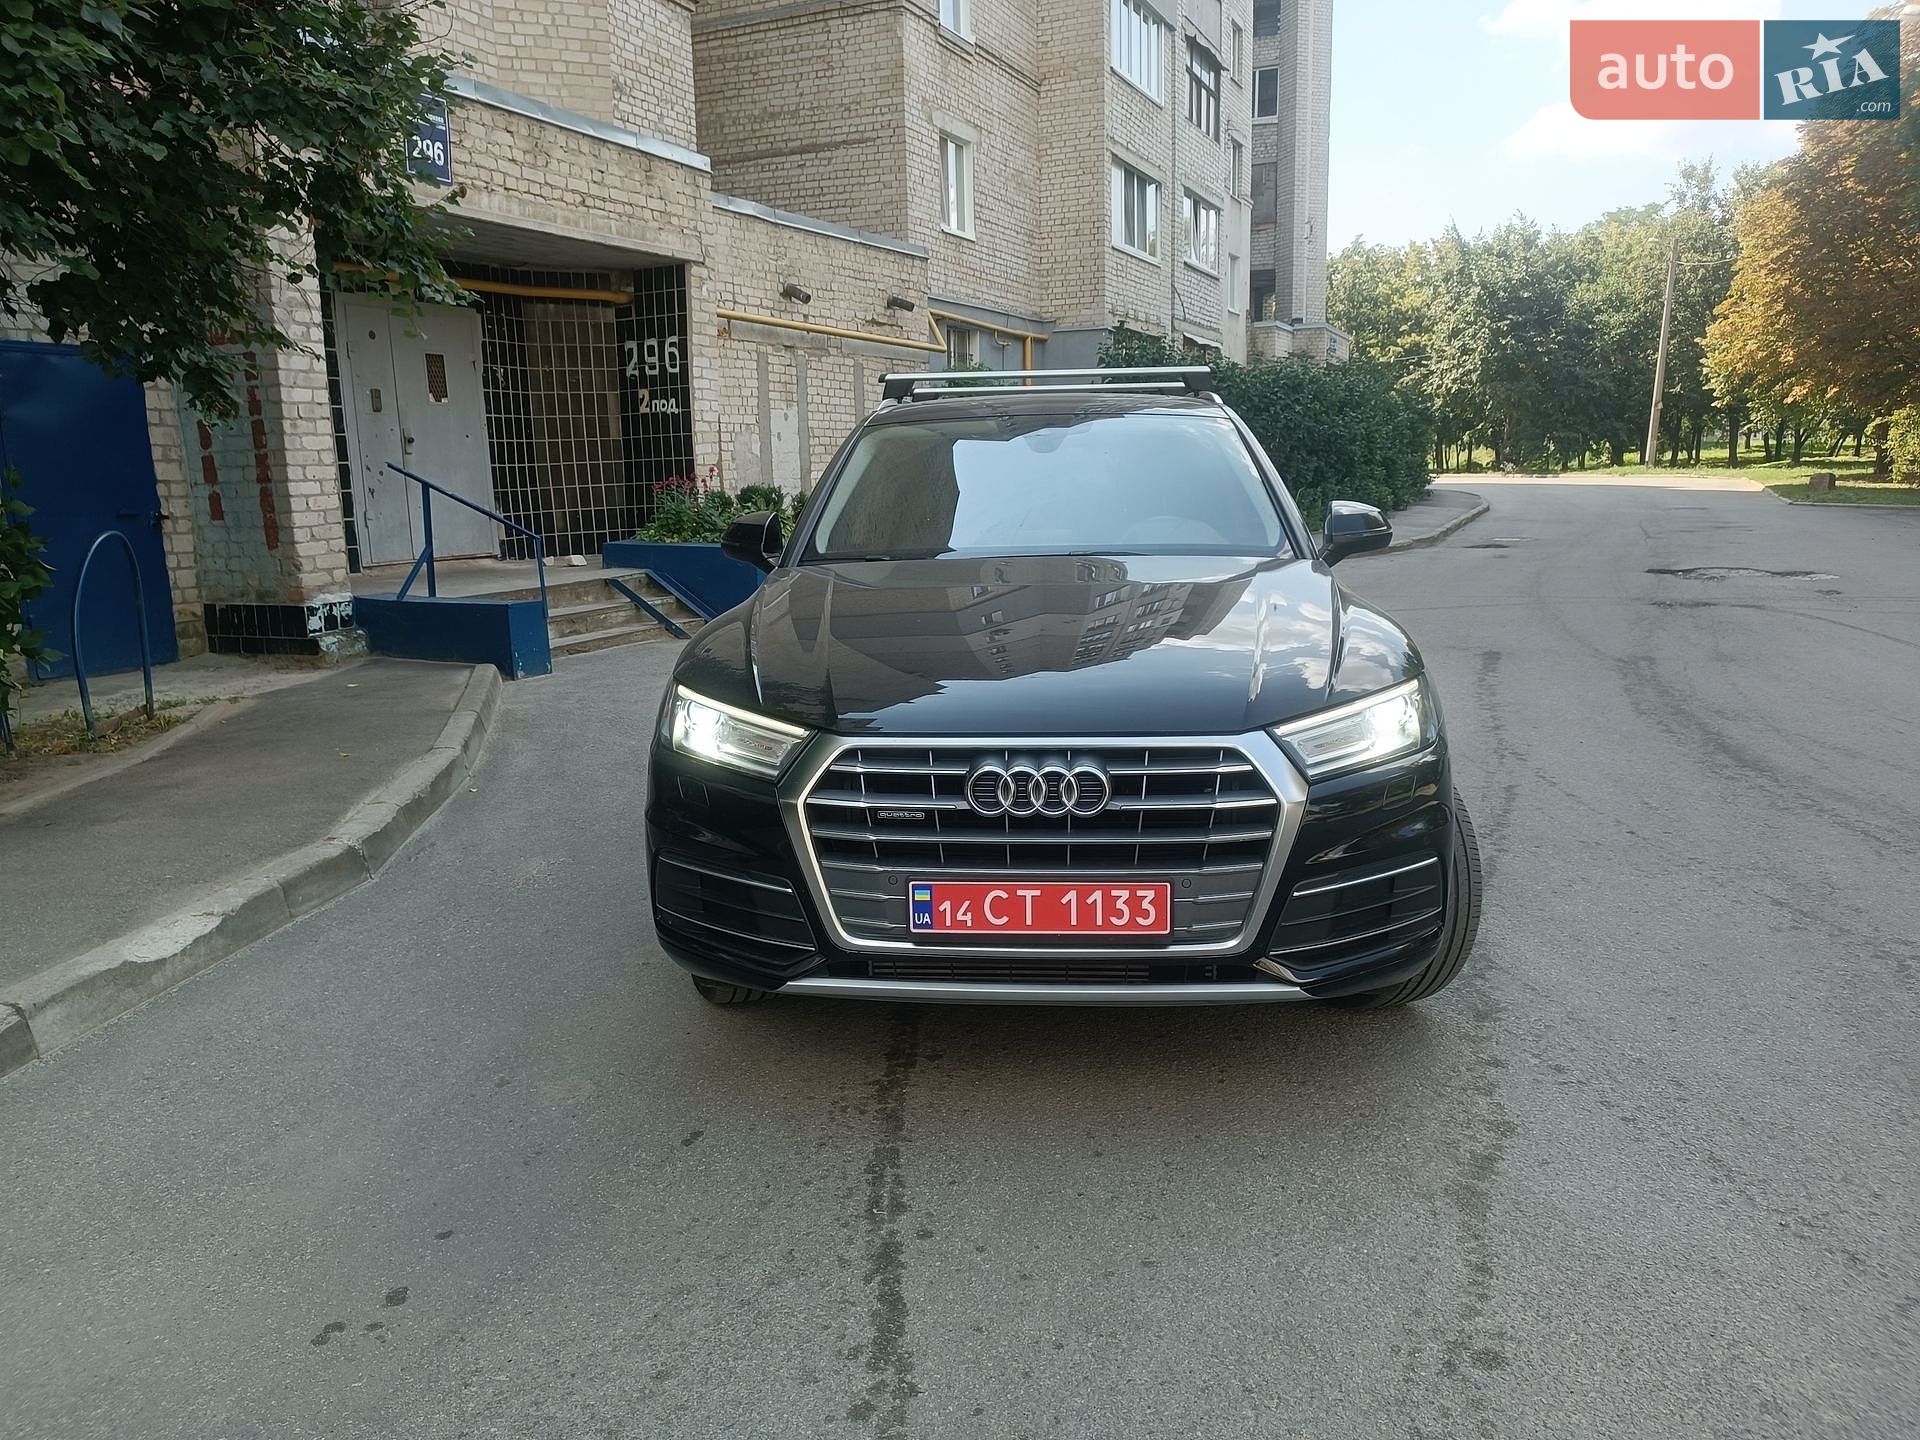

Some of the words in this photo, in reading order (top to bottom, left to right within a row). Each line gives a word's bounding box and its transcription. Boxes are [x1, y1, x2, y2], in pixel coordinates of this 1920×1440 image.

[412, 135, 445, 166] 296
[625, 336, 679, 377] 296
[639, 388, 650, 413] 2
[915, 912, 931, 925] UA
[938, 900, 972, 927] 14
[1060, 889, 1157, 927] 1133
